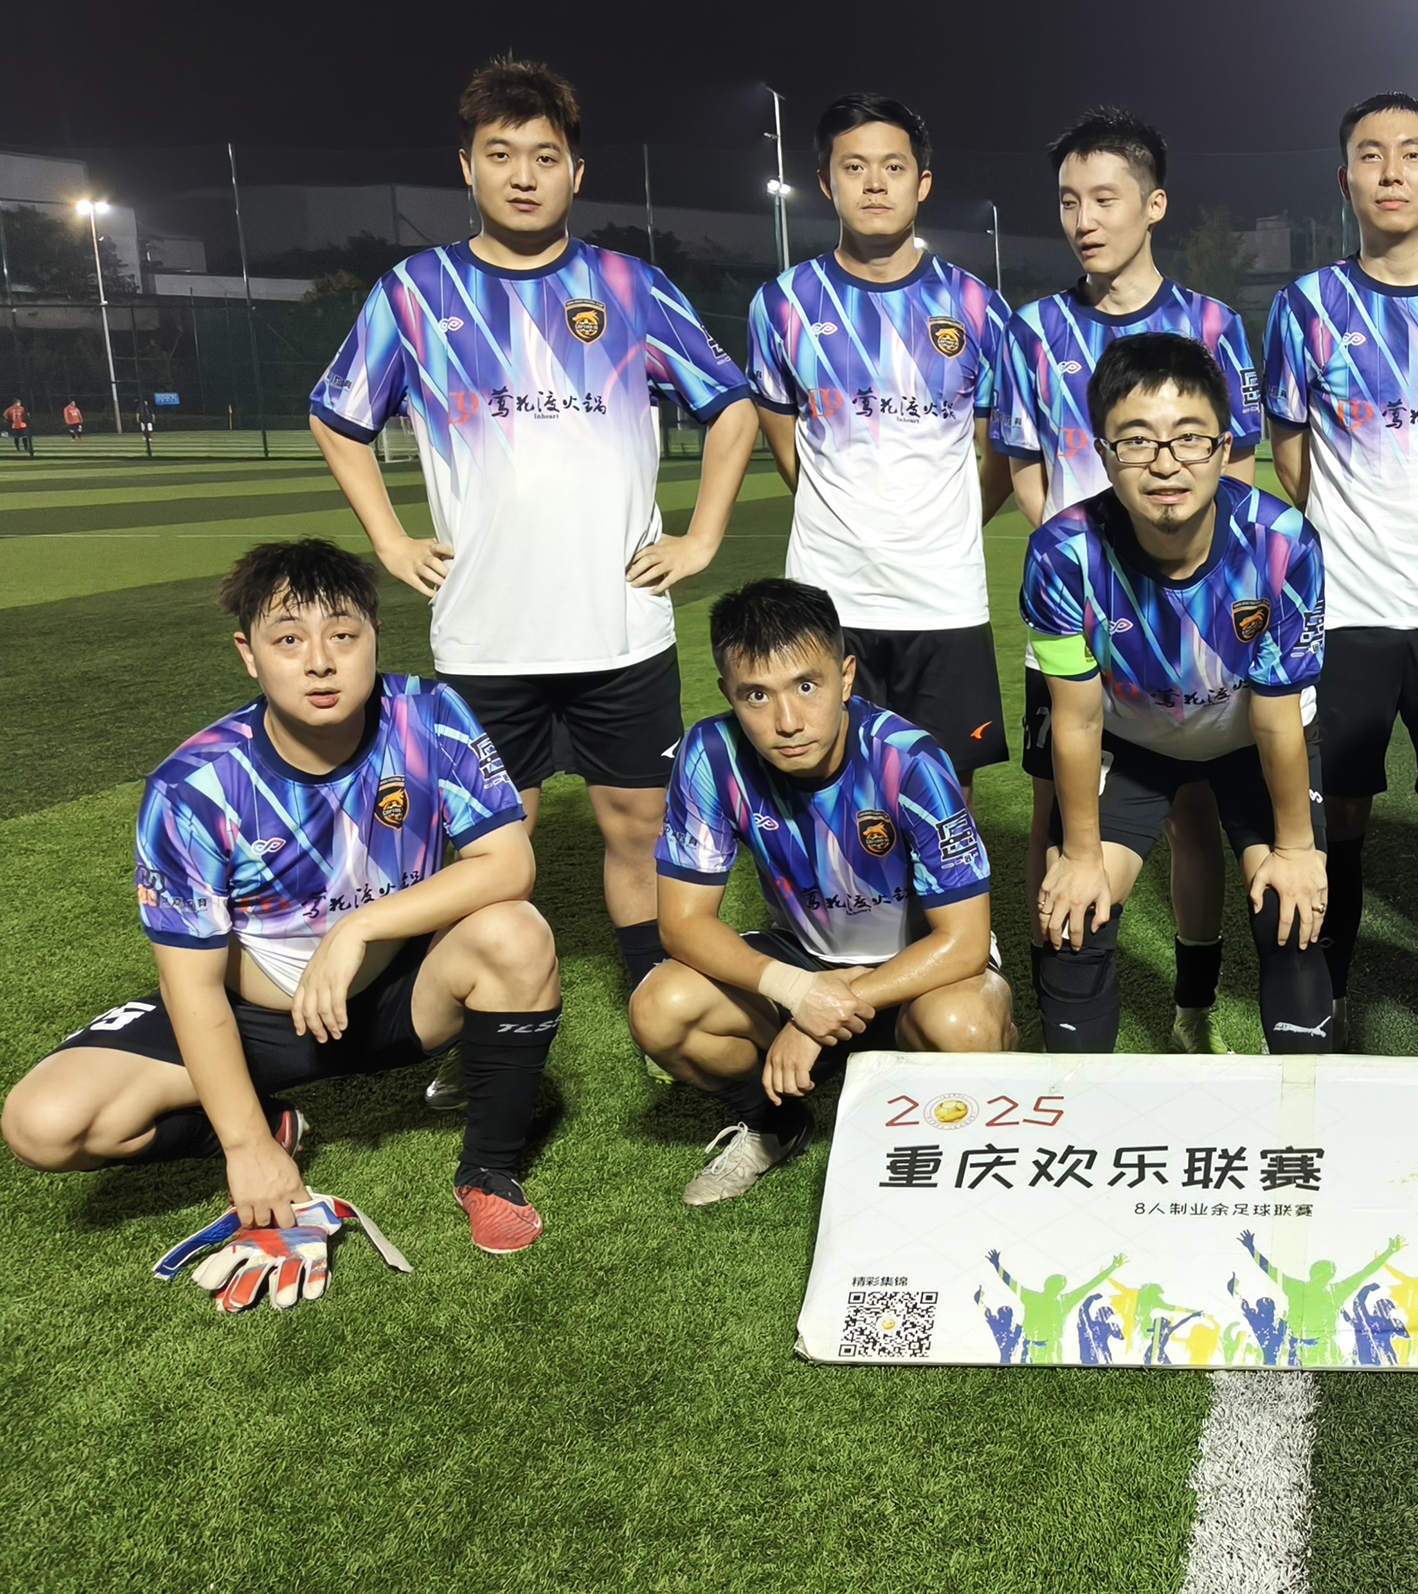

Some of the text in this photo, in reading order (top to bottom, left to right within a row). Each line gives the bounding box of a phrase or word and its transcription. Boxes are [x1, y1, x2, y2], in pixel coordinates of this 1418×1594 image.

[878, 1142, 1326, 1192] 重庆欢乐联赛
[1133, 1202, 1314, 1217] 8人制业余足球联赛
[851, 1276, 909, 1287] 精彩集锦
